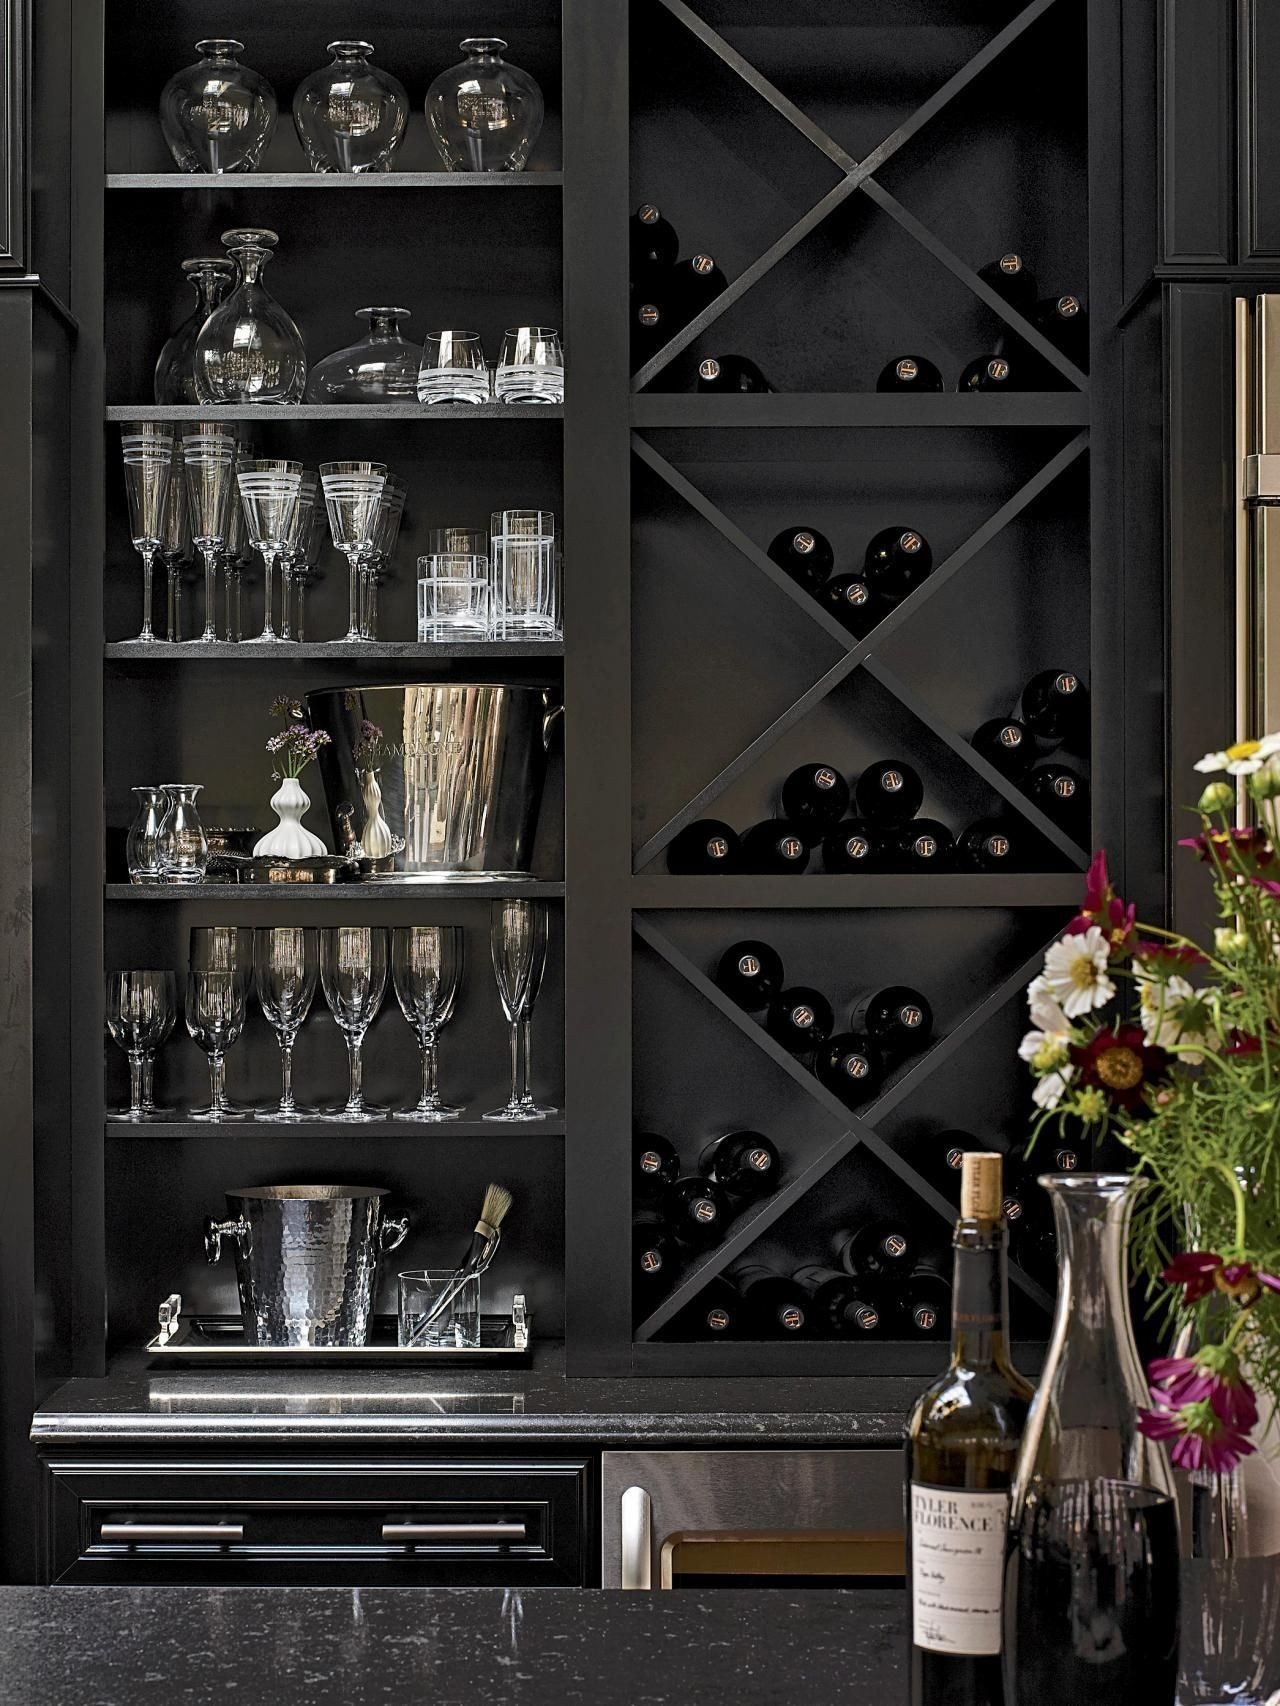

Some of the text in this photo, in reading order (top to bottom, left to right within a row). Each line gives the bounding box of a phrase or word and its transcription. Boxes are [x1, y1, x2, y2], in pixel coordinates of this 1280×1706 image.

[363, 742, 462, 756] HAMPAGNE
[915, 1495, 958, 1514] TYLER
[914, 1511, 993, 1531] FLORENCE
